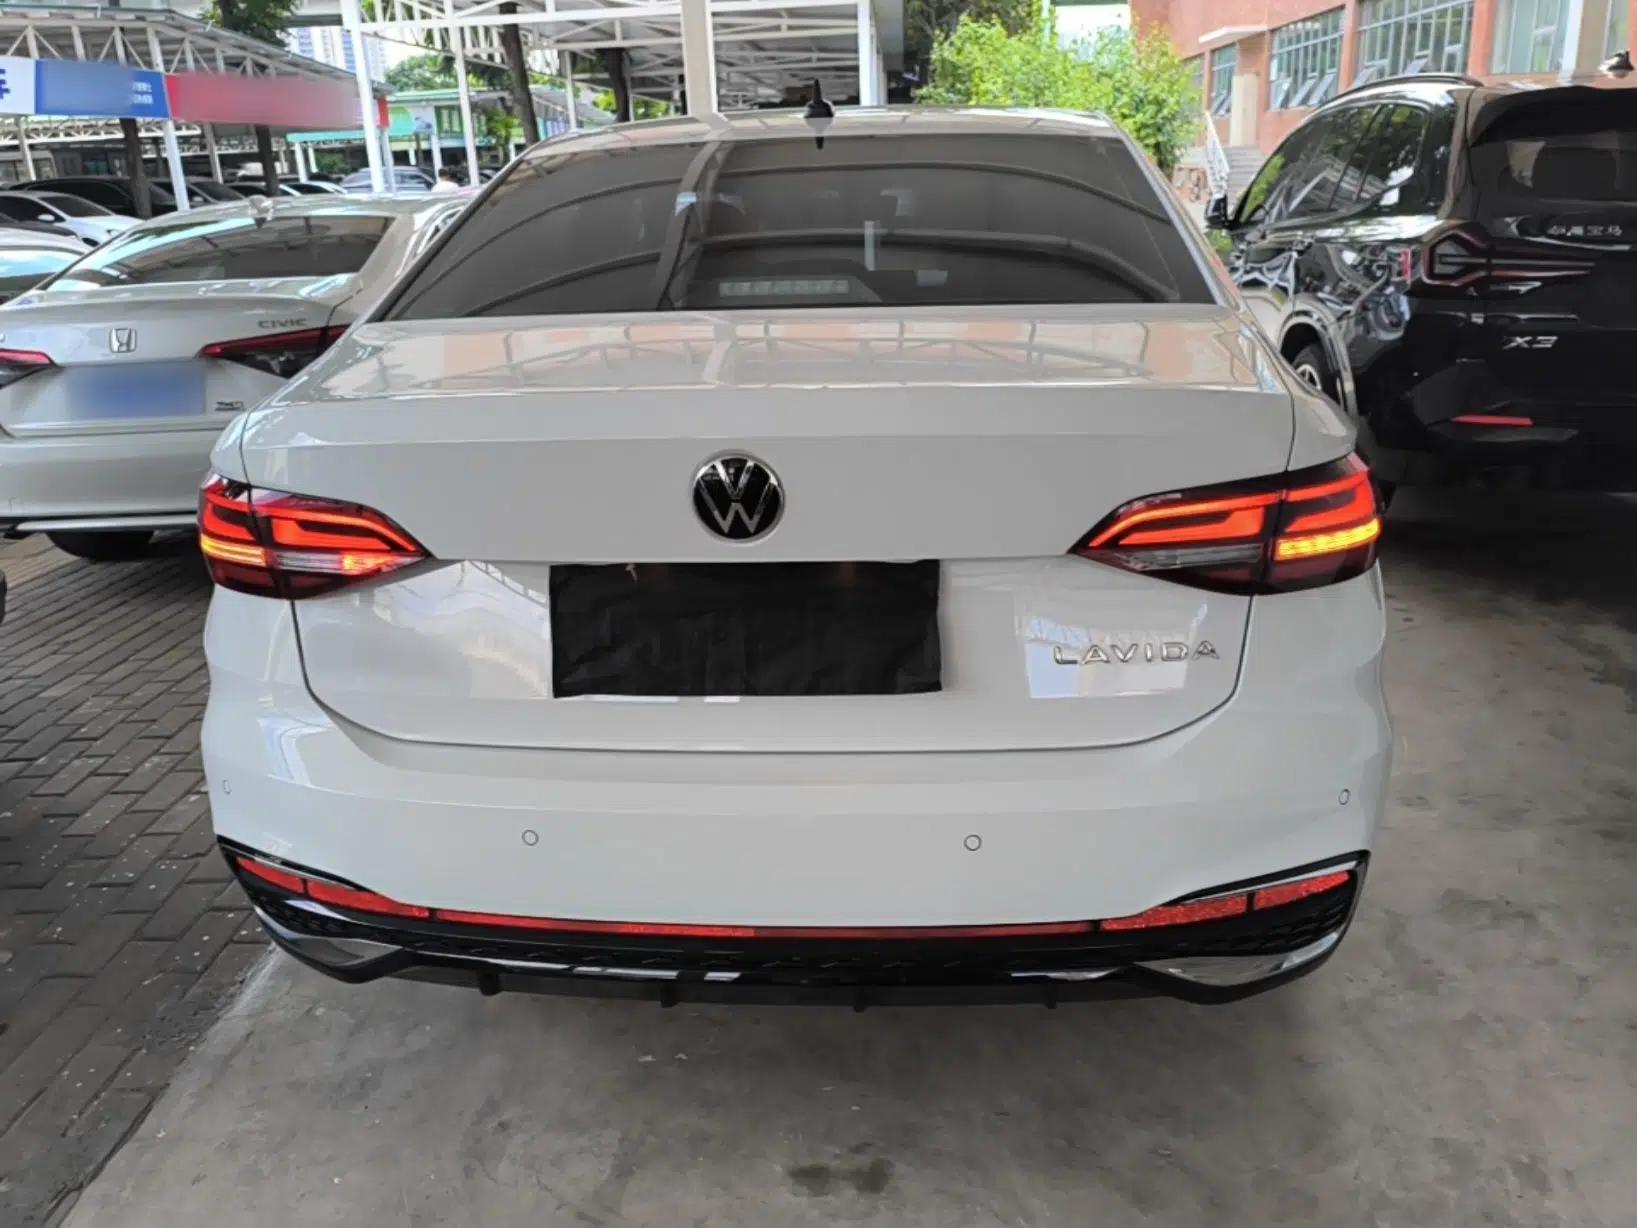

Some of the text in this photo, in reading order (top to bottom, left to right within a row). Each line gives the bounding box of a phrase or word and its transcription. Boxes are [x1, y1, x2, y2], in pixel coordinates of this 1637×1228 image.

[257, 318, 308, 329] CIVIC
[1502, 336, 1559, 350] X3
[694, 455, 782, 540] VW
[1053, 640, 1221, 665] LAVIDA
